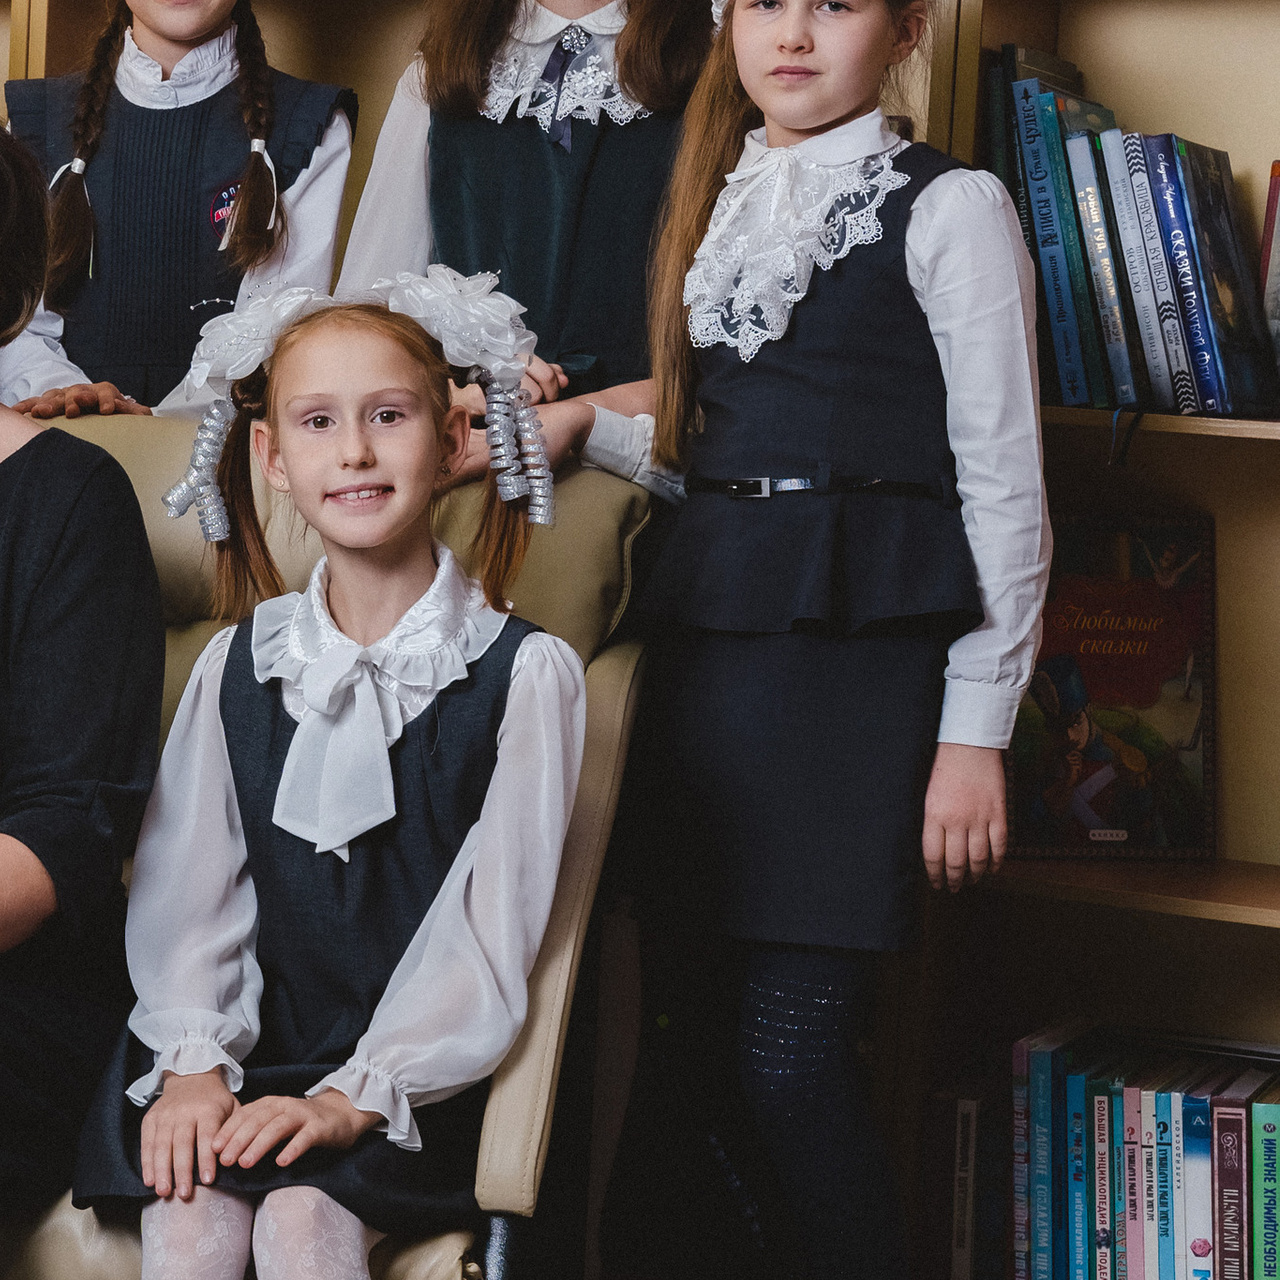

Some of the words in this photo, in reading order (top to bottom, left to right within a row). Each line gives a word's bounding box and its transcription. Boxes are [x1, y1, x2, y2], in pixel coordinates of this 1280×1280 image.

[1023, 104, 1042, 146] ЧУДЕС
[1135, 181, 1158, 242] КРАСАВИЦА
[1051, 255, 1068, 324] Приключения
[1125, 247, 1142, 294] ОСТРОВ
[1150, 246, 1168, 294] СПЯЩАЯ
[1142, 305, 1158, 358] СТИВЕНСОН
[1170, 229, 1194, 288] СКАЗКИ
[1183, 290, 1206, 348] ГОЛУБОЙ
[1196, 351, 1212, 382] ФЕИ
[1053, 604, 1164, 632] Любимые
[1080, 636, 1149, 656] сказки
[1097, 1099, 1106, 1144] БОЛЬШАЯ
[1035, 1123, 1050, 1176] ДАВАЙТЕ
[1174, 1120, 1182, 1190] КАЛЕЙДОСКОП
[1261, 1137, 1278, 1184] ЗНАНИЙ
[1097, 1151, 1108, 1226] ЭНЦИКЛОПЕДИЯ
[1036, 1183, 1050, 1248] СОЗДАДИМ
[1074, 1191, 1084, 1266] энциклопедия
[1116, 1211, 1128, 1248] ДОМА
[1223, 1188, 1240, 1252] МУДРОСТИ
[1263, 1187, 1280, 1278] НЕОБХОДИМЫХ
